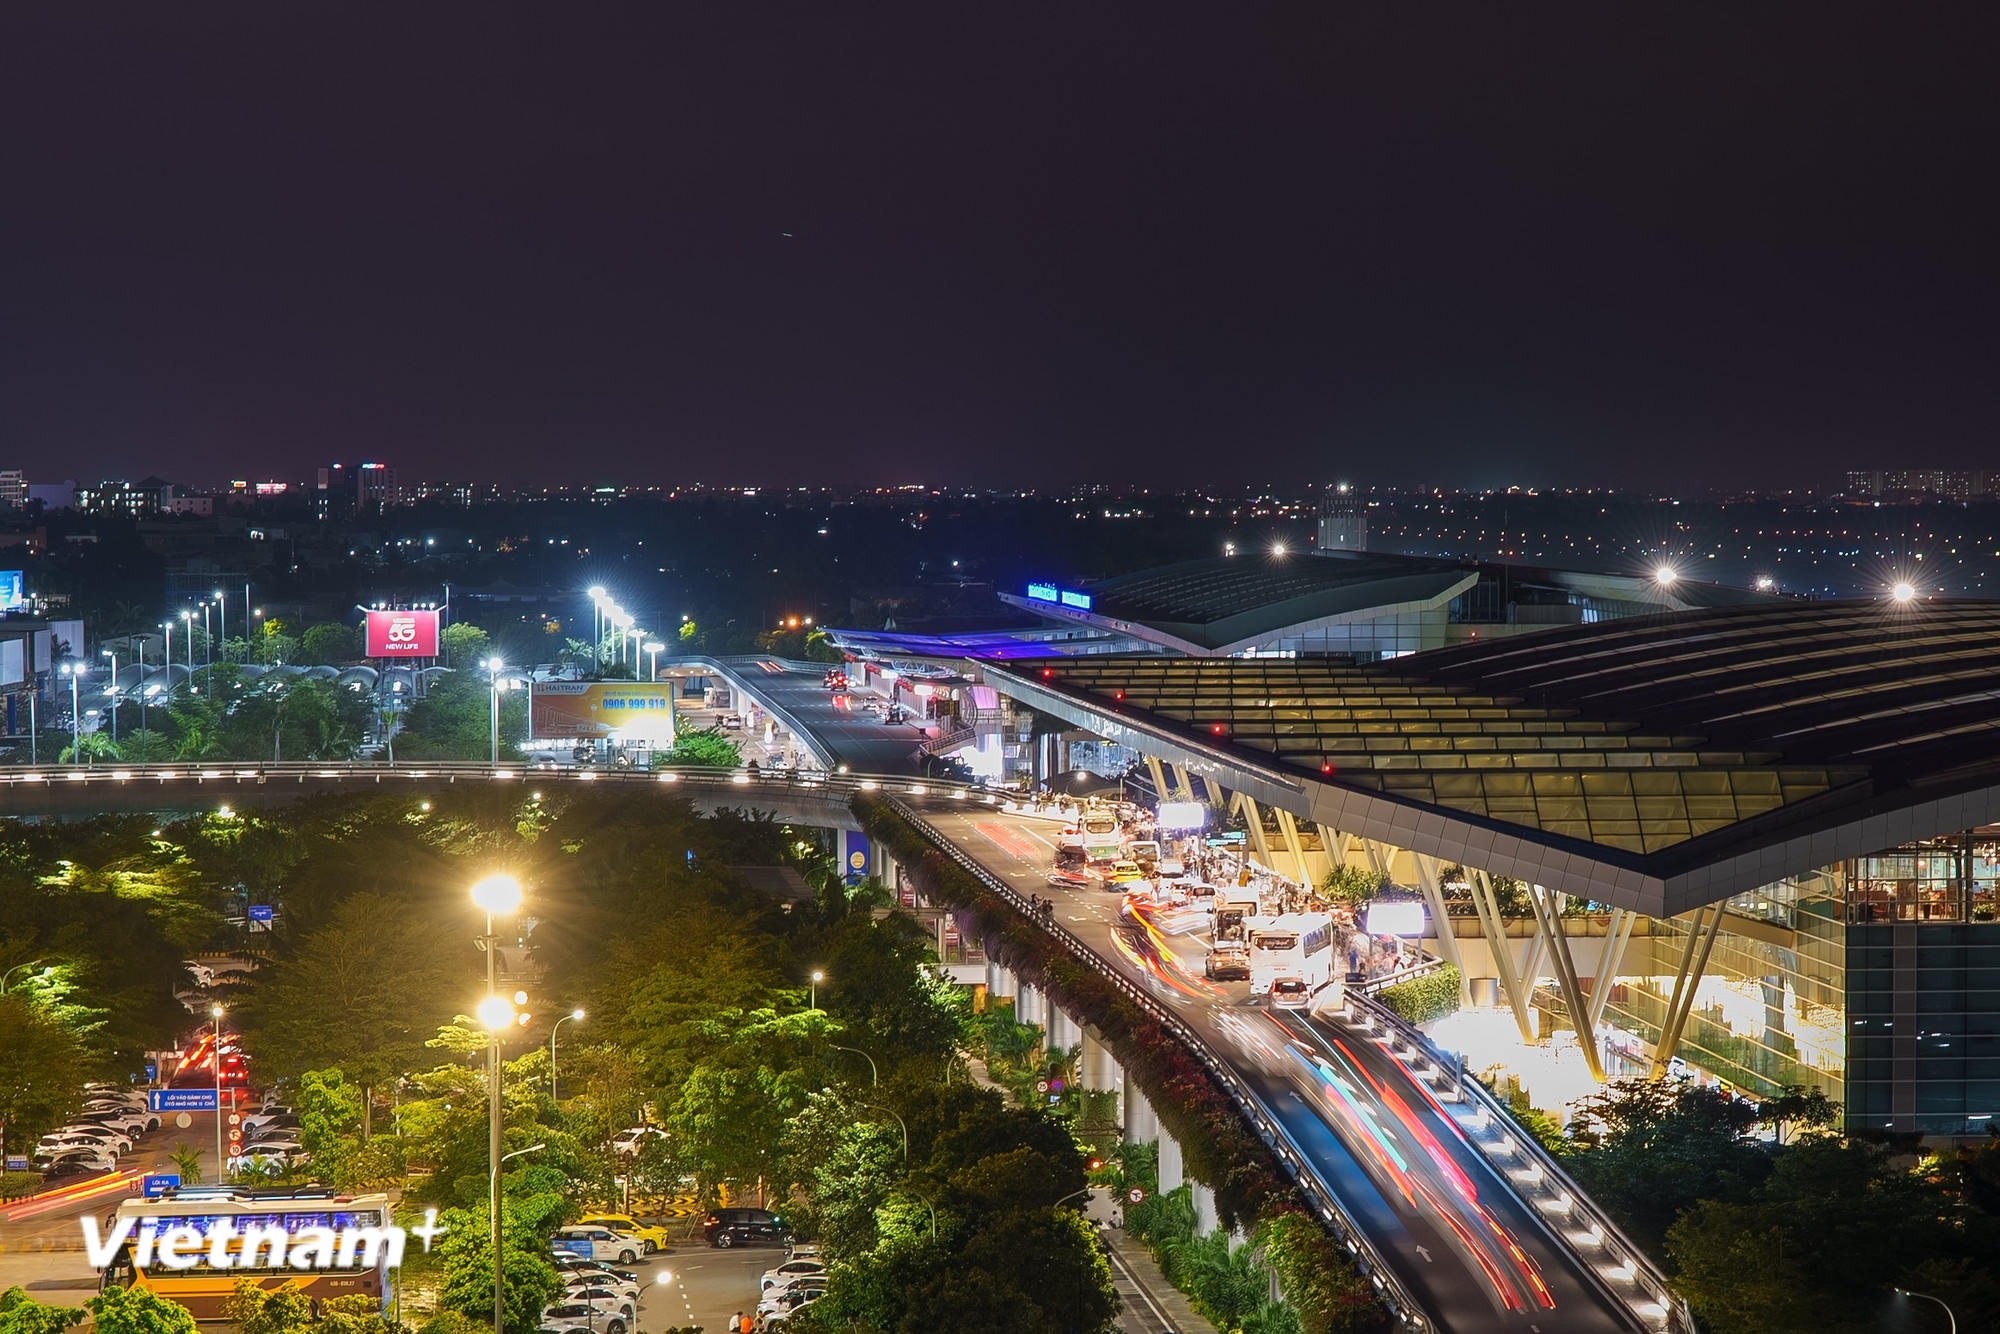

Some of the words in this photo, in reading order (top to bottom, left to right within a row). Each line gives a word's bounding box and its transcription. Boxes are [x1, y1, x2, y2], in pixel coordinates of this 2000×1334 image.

[388, 623, 416, 642] 5G
[602, 698, 626, 709] 0906
[628, 698, 646, 709] 999
[648, 698, 666, 709] 919
